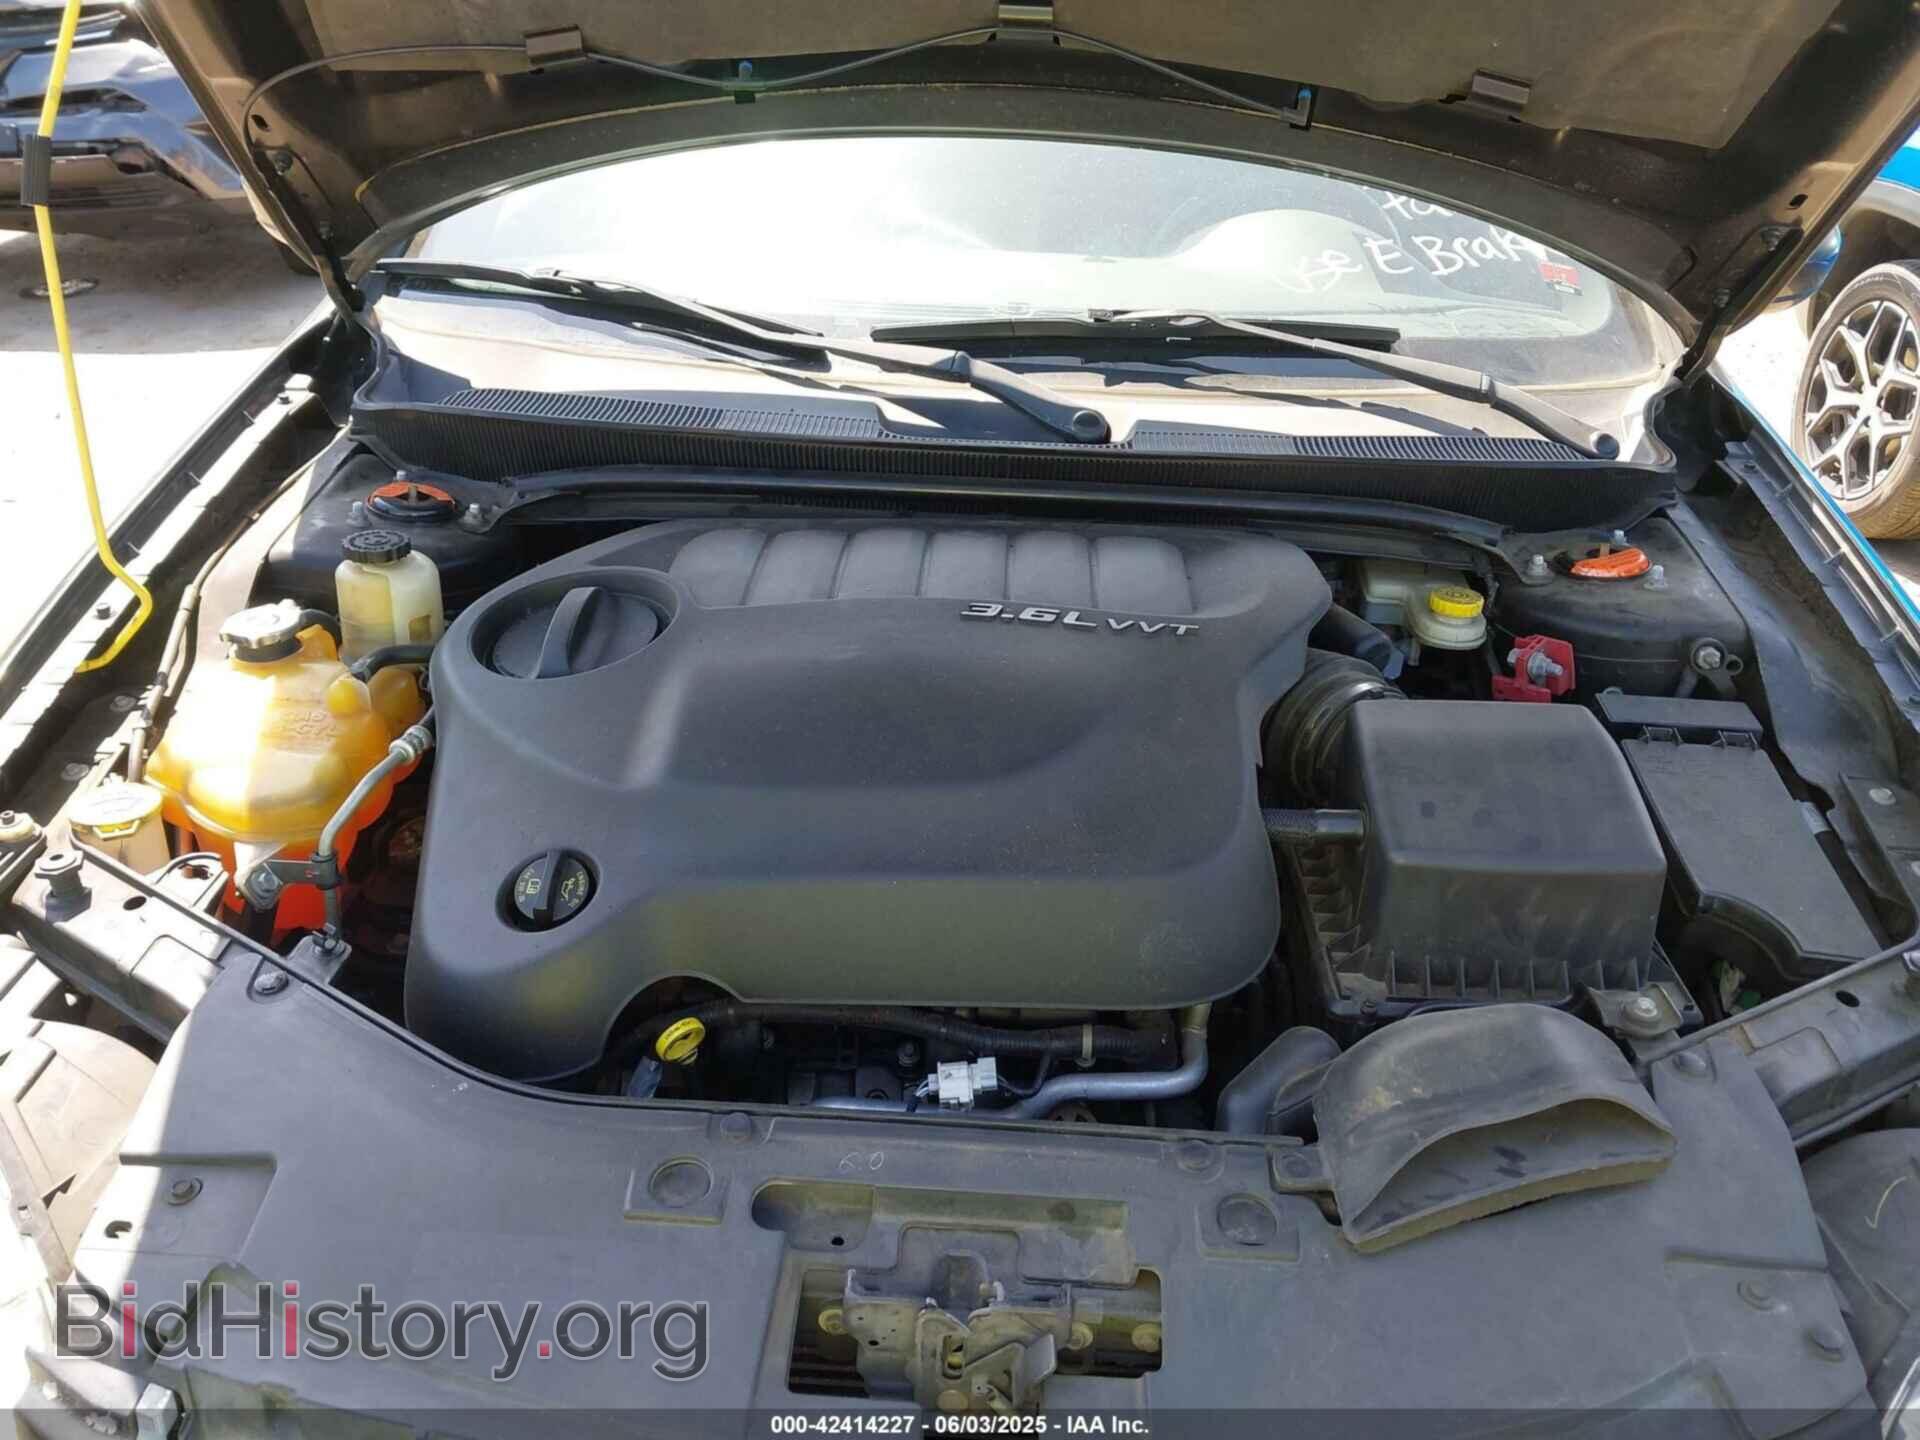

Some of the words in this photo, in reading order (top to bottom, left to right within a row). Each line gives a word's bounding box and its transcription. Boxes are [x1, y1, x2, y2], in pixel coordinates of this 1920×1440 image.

[1362, 237, 1415, 275] E
[960, 602, 1098, 628] 3.6L
[1107, 617, 1200, 636] VVT
